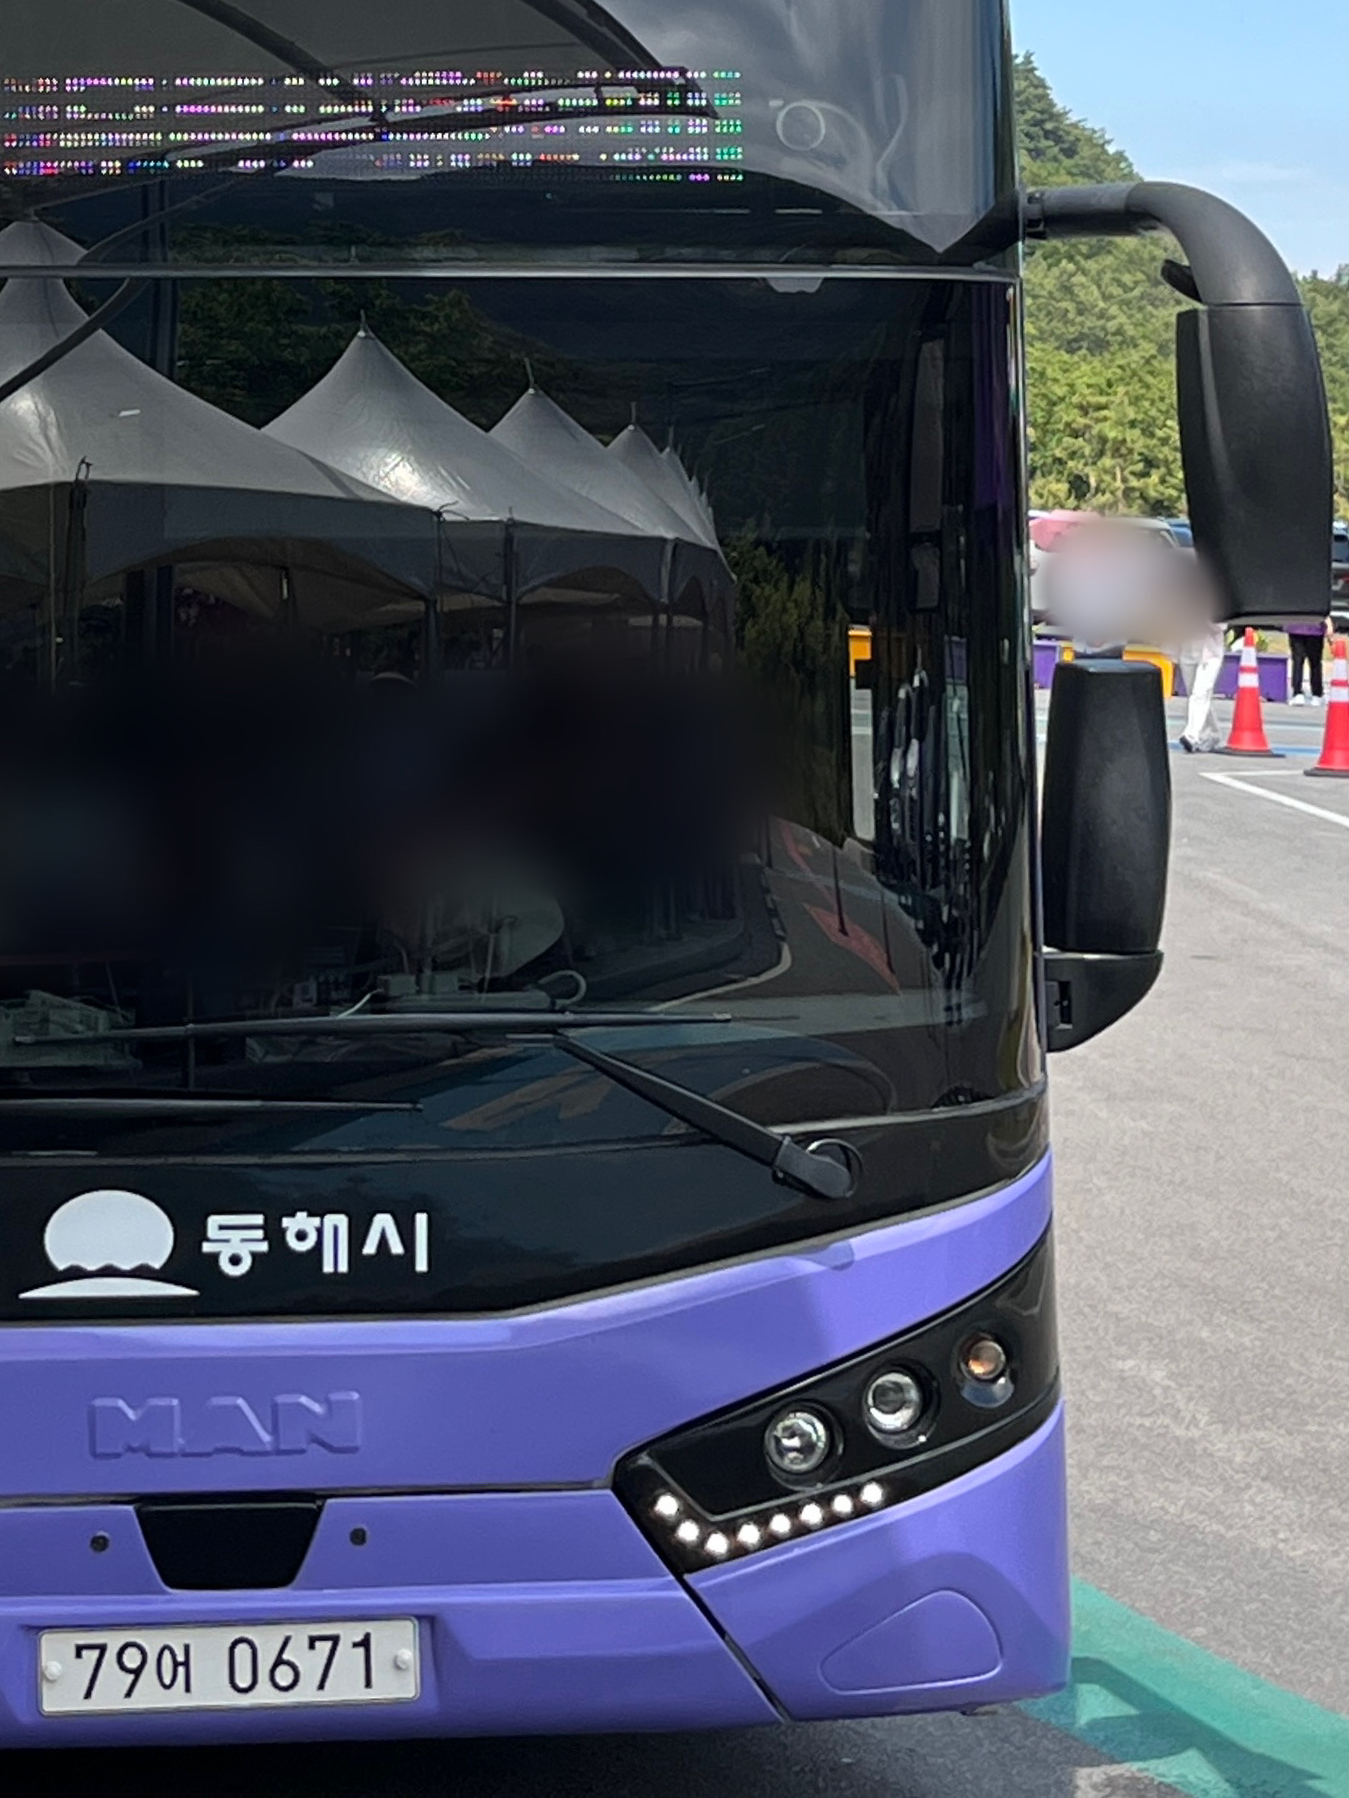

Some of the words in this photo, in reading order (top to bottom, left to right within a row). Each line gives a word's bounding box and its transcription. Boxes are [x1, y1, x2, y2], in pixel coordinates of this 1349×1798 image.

[201, 1211, 429, 1277] 동해시
[87, 1391, 363, 1459] MAN
[74, 1640, 192, 1700] 79어
[228, 1631, 374, 1694] 0671
